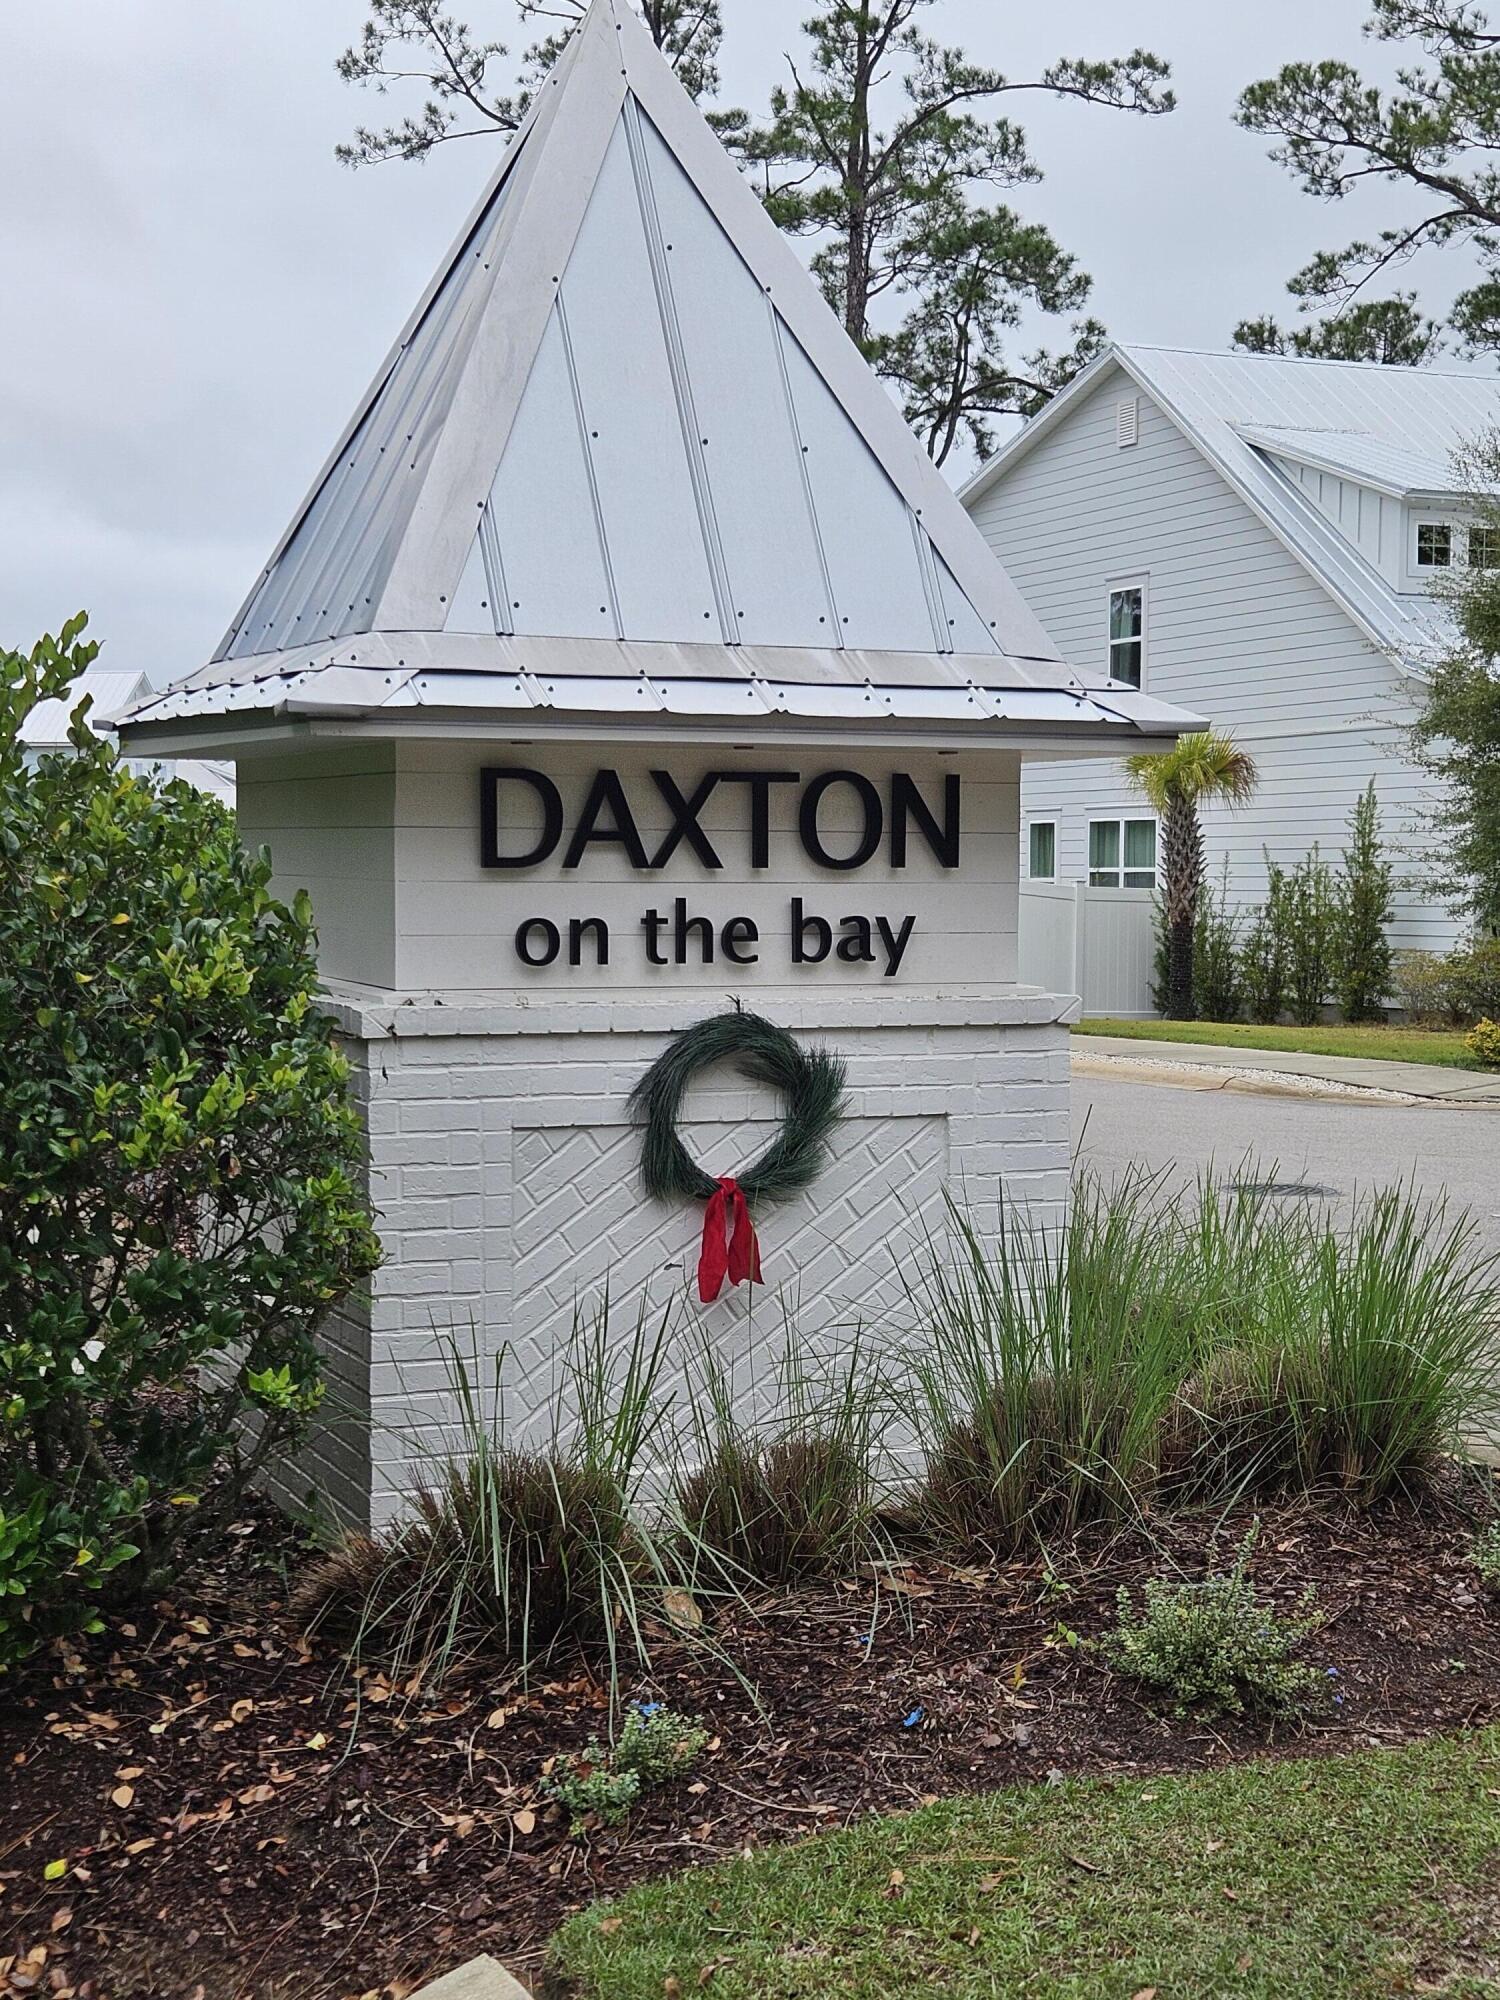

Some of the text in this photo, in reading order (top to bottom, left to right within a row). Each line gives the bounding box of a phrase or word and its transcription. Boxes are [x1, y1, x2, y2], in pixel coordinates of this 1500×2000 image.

[480, 767, 960, 870] DAXTON
[515, 897, 916, 977] on the bay
